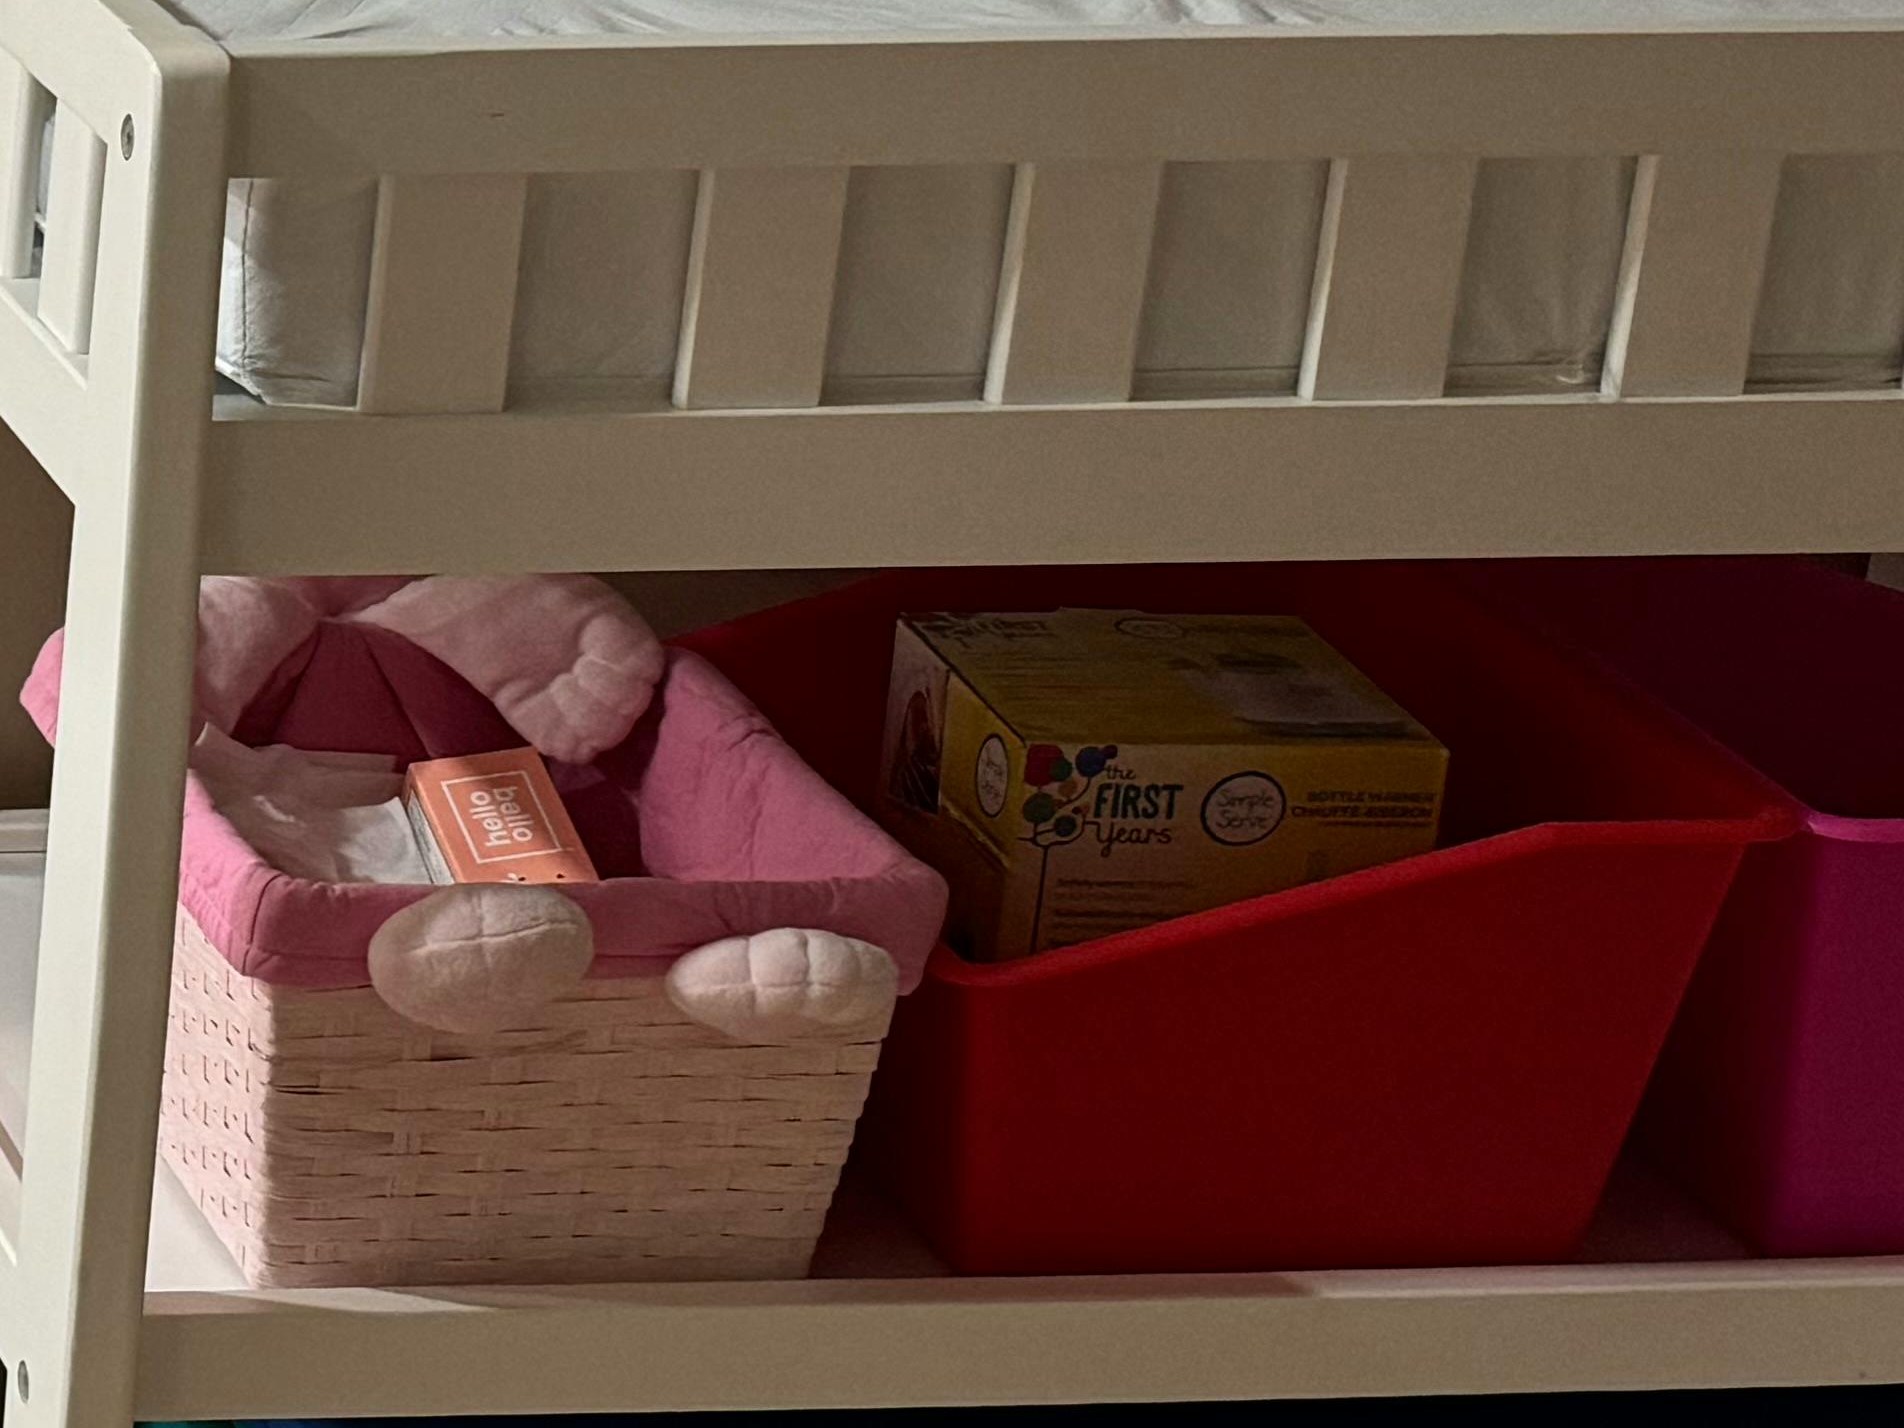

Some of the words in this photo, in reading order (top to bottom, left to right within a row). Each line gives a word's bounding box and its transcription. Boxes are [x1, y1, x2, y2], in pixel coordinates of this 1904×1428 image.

[1103, 763, 1137, 780] the
[469, 791, 512, 847] hello
[1094, 783, 1183, 820] FIRST
[1215, 809, 1267, 829] Serve
[1091, 820, 1173, 858] Years
